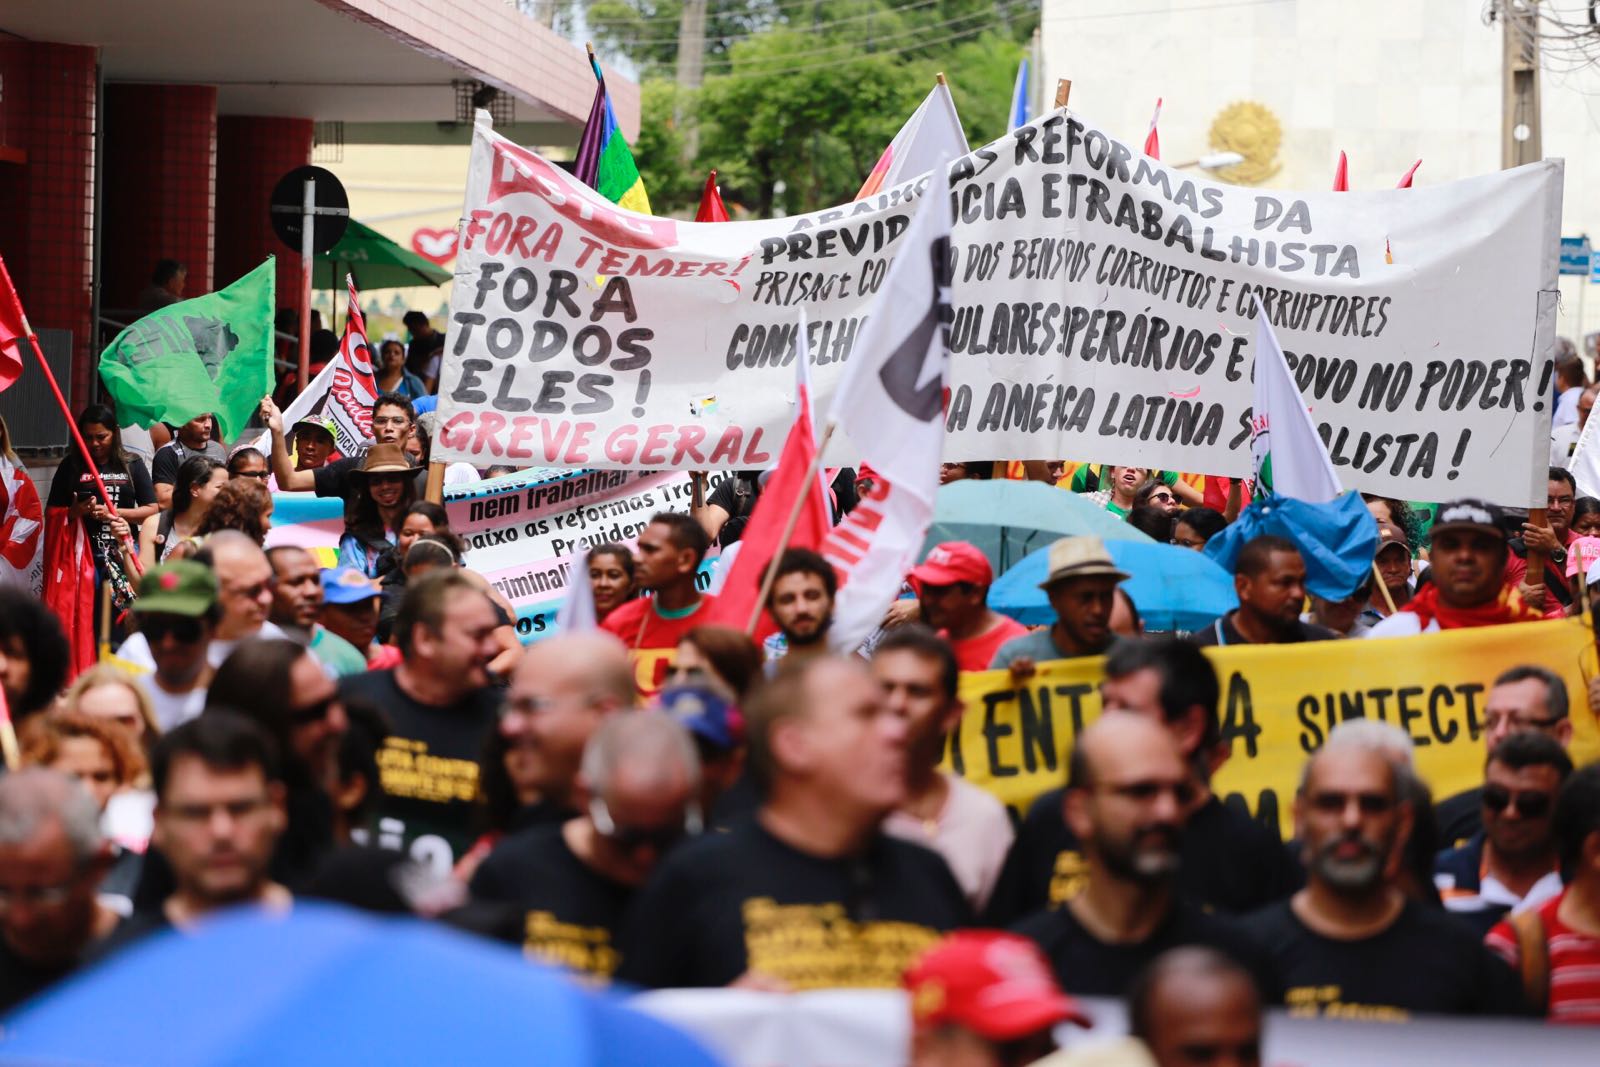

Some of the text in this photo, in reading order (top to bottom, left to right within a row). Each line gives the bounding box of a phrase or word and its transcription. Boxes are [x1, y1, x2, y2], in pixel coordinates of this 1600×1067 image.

[1014, 116, 1223, 218] REFORMAS
[1253, 196, 1312, 235] DA
[463, 210, 755, 278] FORA TEMER!
[1067, 173, 1360, 279] TRABALHISTA
[473, 262, 638, 323] FORA
[963, 241, 1004, 283] DOS
[1008, 238, 1065, 280] BENS
[1096, 244, 1217, 308] CORRUPTOS
[1218, 280, 1235, 313] E
[1236, 282, 1392, 338] CORRUPTORES
[453, 312, 654, 372] TODOS
[1226, 337, 1248, 382] E
[1281, 350, 1358, 404] POVO
[1358, 360, 1413, 412] NO
[439, 410, 770, 466] GREVE GERAL
[1098, 391, 1223, 446] LATINA
[470, 470, 634, 522] nem trabalhar
[524, 519, 550, 539] as
[554, 492, 655, 530] reformas
[491, 562, 571, 600] riminali
